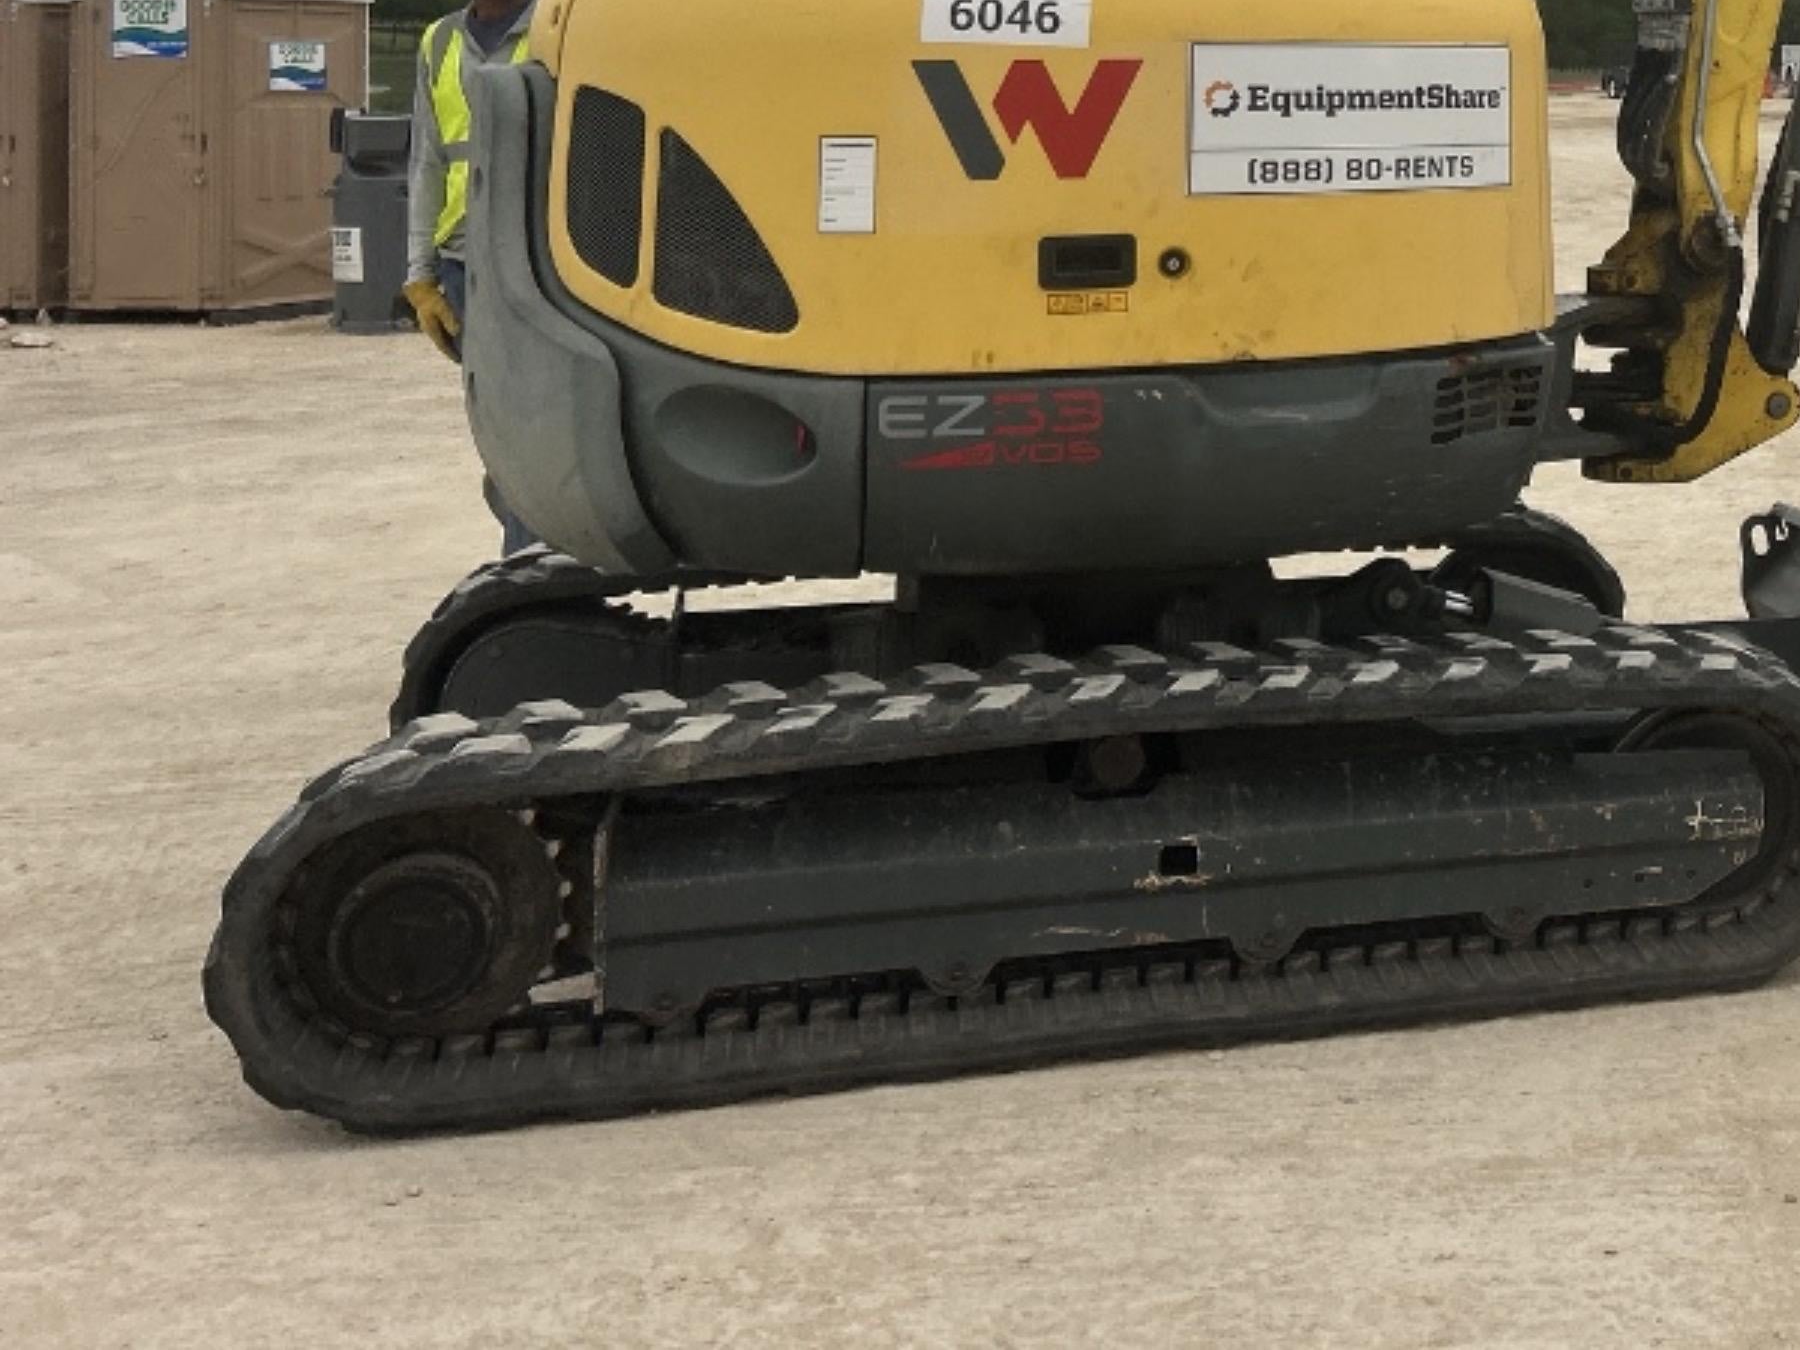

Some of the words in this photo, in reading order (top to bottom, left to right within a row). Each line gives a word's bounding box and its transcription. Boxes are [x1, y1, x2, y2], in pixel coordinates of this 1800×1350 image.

[1248, 84, 1501, 117] EquipmentShare
[1248, 158, 1334, 184] (888)
[1346, 155, 1475, 181] 80-RENTS
